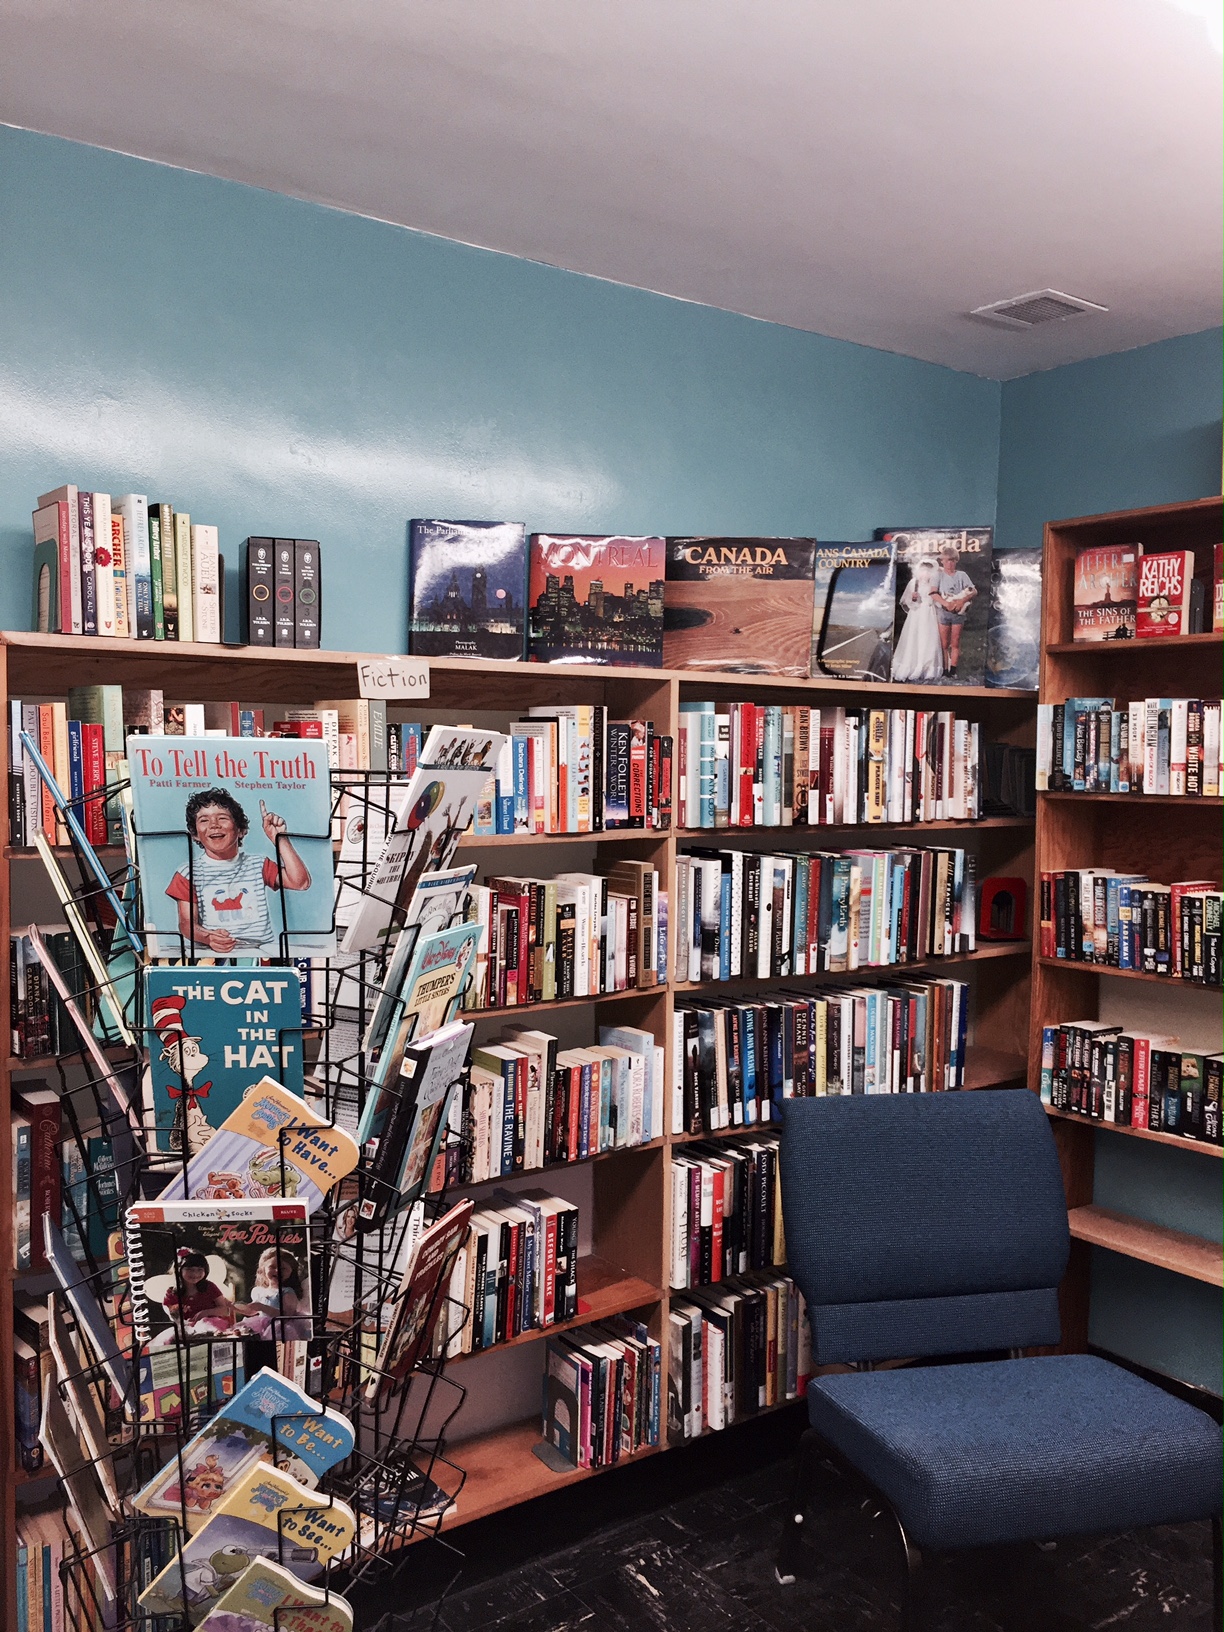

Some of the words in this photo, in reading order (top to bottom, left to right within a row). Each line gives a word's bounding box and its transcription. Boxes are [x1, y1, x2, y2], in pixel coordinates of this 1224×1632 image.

[417, 525, 433, 534] The
[111, 521, 122, 566] ARCHER
[842, 547, 890, 558] CANADA
[892, 531, 980, 553] Canada
[536, 544, 658, 569] MONTREAL
[685, 546, 788, 565] CANADA
[819, 559, 871, 569] COUNTRY
[1080, 552, 1134, 574] JEFFRE
[200, 552, 209, 582] AUEL
[699, 565, 731, 575] FROM
[732, 566, 753, 575] THE
[755, 566, 773, 575] AIR
[1142, 558, 1181, 579] KATHY
[1079, 572, 1137, 590] ARCHER
[1139, 576, 1182, 597] REICHS
[305, 608, 310, 616] 3
[1096, 608, 1118, 616] SINS
[1099, 615, 1136, 625] FATHER
[360, 665, 427, 688] Fiction
[800, 710, 808, 723] DAN
[373, 710, 383, 748] EMILIE
[800, 726, 808, 751] BROWN
[1146, 710, 1157, 747] BILLINGHAM
[618, 732, 627, 754] KEN
[1075, 739, 1083, 762] Barclay
[136, 749, 163, 778] To
[168, 749, 208, 778] Tell
[215, 750, 248, 779] the
[253, 751, 317, 779] Truth
[1188, 746, 1198, 773] WHITE
[149, 779, 173, 788] Patti
[175, 780, 212, 788] Farmer
[234, 781, 269, 790] Stephen
[270, 781, 306, 791] Taylor
[618, 758, 627, 806] FOLLETT
[632, 763, 642, 813] CORRECTIONS
[1188, 776, 1198, 792] HOT
[838, 876, 848, 927] PrairyErth
[660, 954, 666, 963] Pi
[172, 985, 216, 1000] THE
[220, 980, 288, 1005] CAT
[417, 972, 456, 997] THUMPER'S
[246, 1010, 268, 1023] IN
[834, 1020, 838, 1028] on
[238, 1028, 276, 1041] THE
[224, 1045, 294, 1068] HAT
[633, 1068, 643, 1088] NORA
[505, 1102, 514, 1121] THE
[632, 1088, 642, 1118] ROBERTS
[40, 1119, 58, 1170] Catherine
[276, 1131, 291, 1147] to
[287, 1117, 298, 1128] I
[297, 1122, 338, 1156] Want
[504, 1124, 514, 1157] RAVINE
[219, 1224, 248, 1244] Tea
[245, 1224, 303, 1244] Paries
[527, 1240, 532, 1250] My
[279, 1423, 296, 1438] to
[302, 1417, 343, 1449] Want
[283, 1517, 298, 1531] to
[304, 1509, 345, 1538] Want
[281, 1594, 292, 1605] I
